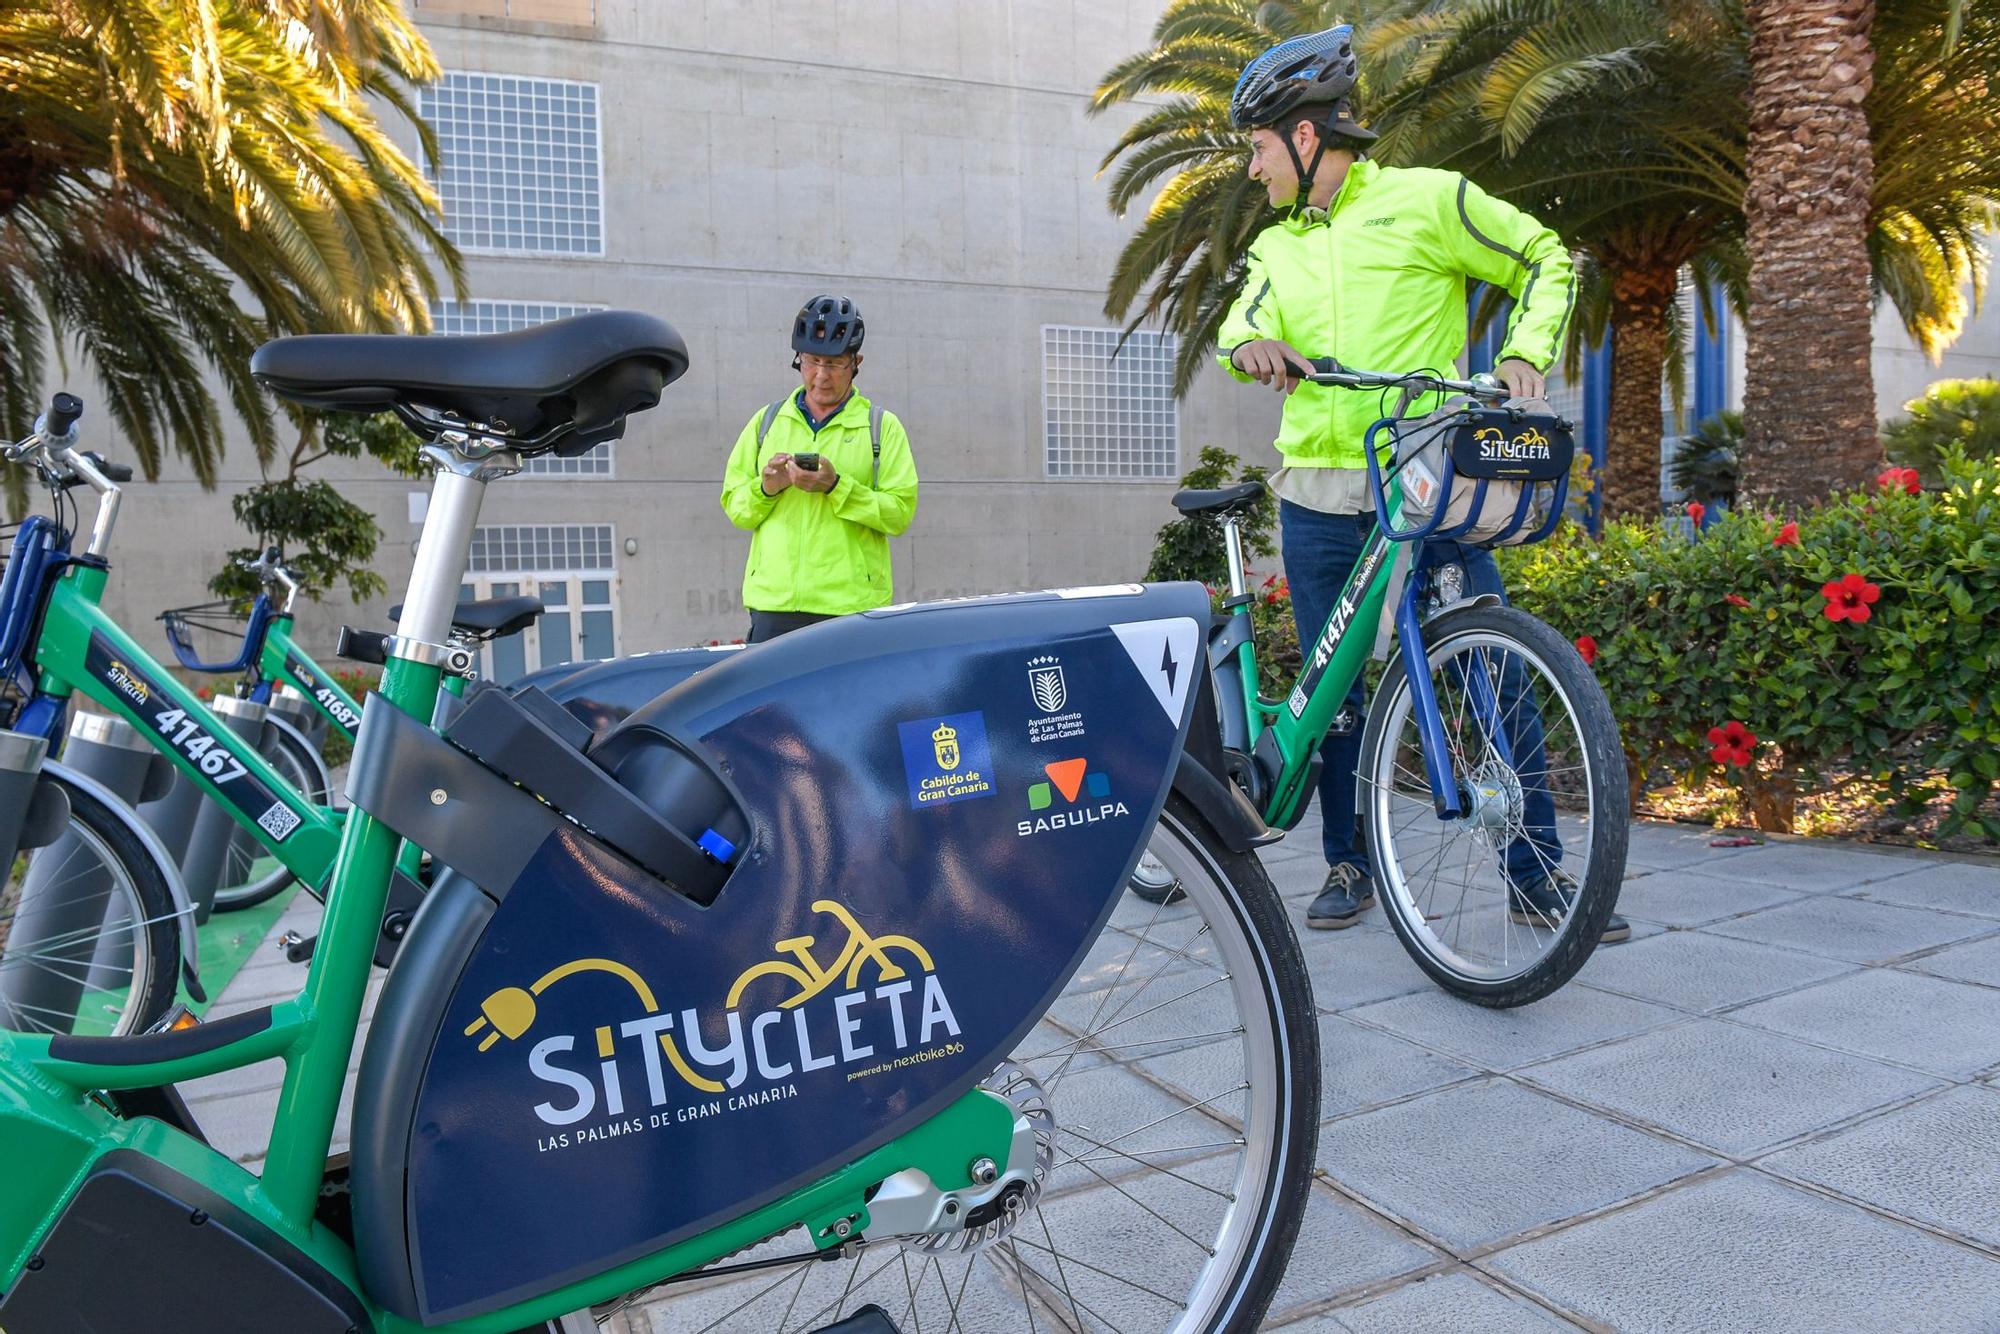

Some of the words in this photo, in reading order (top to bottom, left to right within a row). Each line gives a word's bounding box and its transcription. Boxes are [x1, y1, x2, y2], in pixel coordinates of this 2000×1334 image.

[1315, 596, 1355, 669] 41474
[315, 688, 360, 728] 41687
[1027, 712, 1082, 727] Ayuntamiento
[1029, 727, 1039, 735] de
[1041, 724, 1055, 733] Las
[1057, 720, 1083, 730] Palmas
[1030, 735, 1040, 743] de
[1041, 732, 1058, 741] Gran
[1058, 727, 1085, 738] Canaria
[155, 708, 248, 784] 41467
[918, 789, 946, 801] Gran
[947, 780, 989, 796] Canaria
[921, 773, 963, 789] Cabildo
[965, 770, 980, 781] de
[1017, 802, 1129, 836] SAGULPA
[847, 1065, 881, 1082] powered
[882, 1062, 893, 1073] by
[894, 1047, 946, 1068] nextbike
[538, 1134, 570, 1152] LAS
[576, 1118, 643, 1144] PALMAS
[650, 1112, 670, 1129] DE
[677, 1101, 721, 1122] GRAN
[728, 1084, 798, 1111] CANARIA
